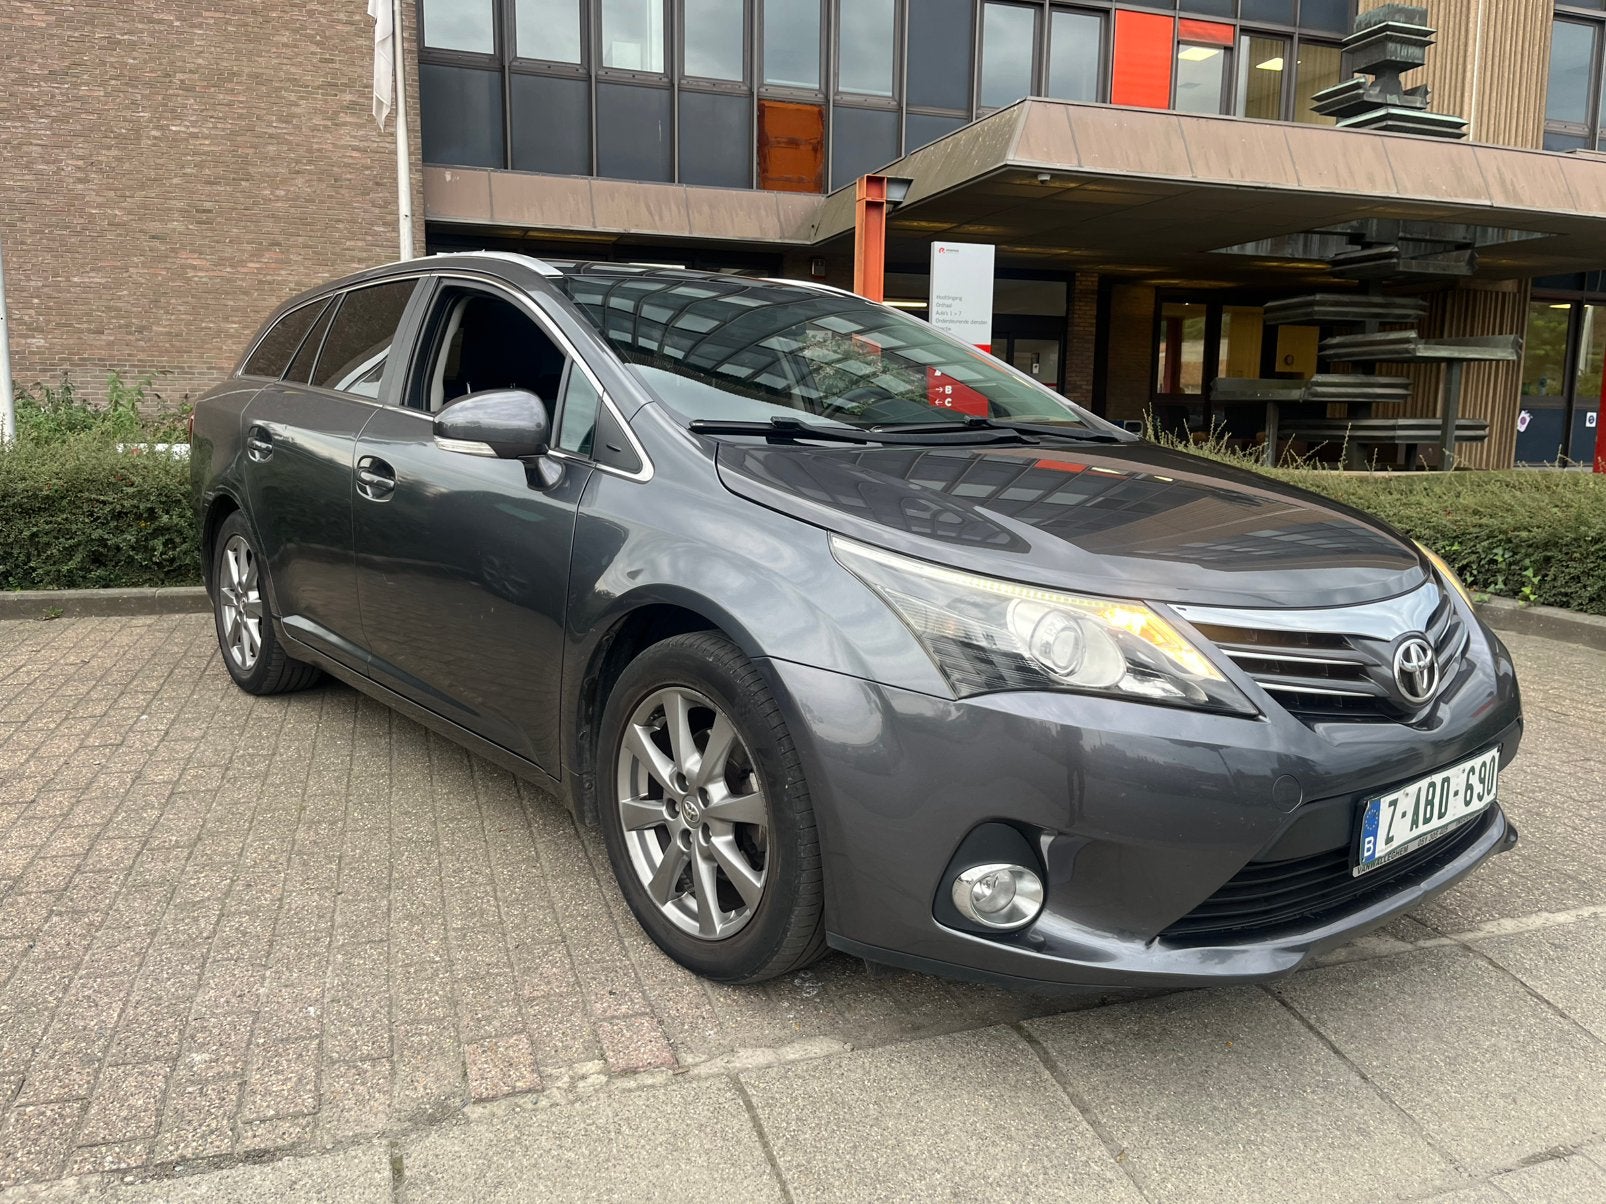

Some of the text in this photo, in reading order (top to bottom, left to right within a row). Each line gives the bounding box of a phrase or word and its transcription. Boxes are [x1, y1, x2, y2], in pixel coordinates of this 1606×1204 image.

[945, 385, 952, 395] B
[945, 397, 952, 407] C
[1385, 755, 1496, 846] Z-ABD-690
[1364, 836, 1375, 857] B
